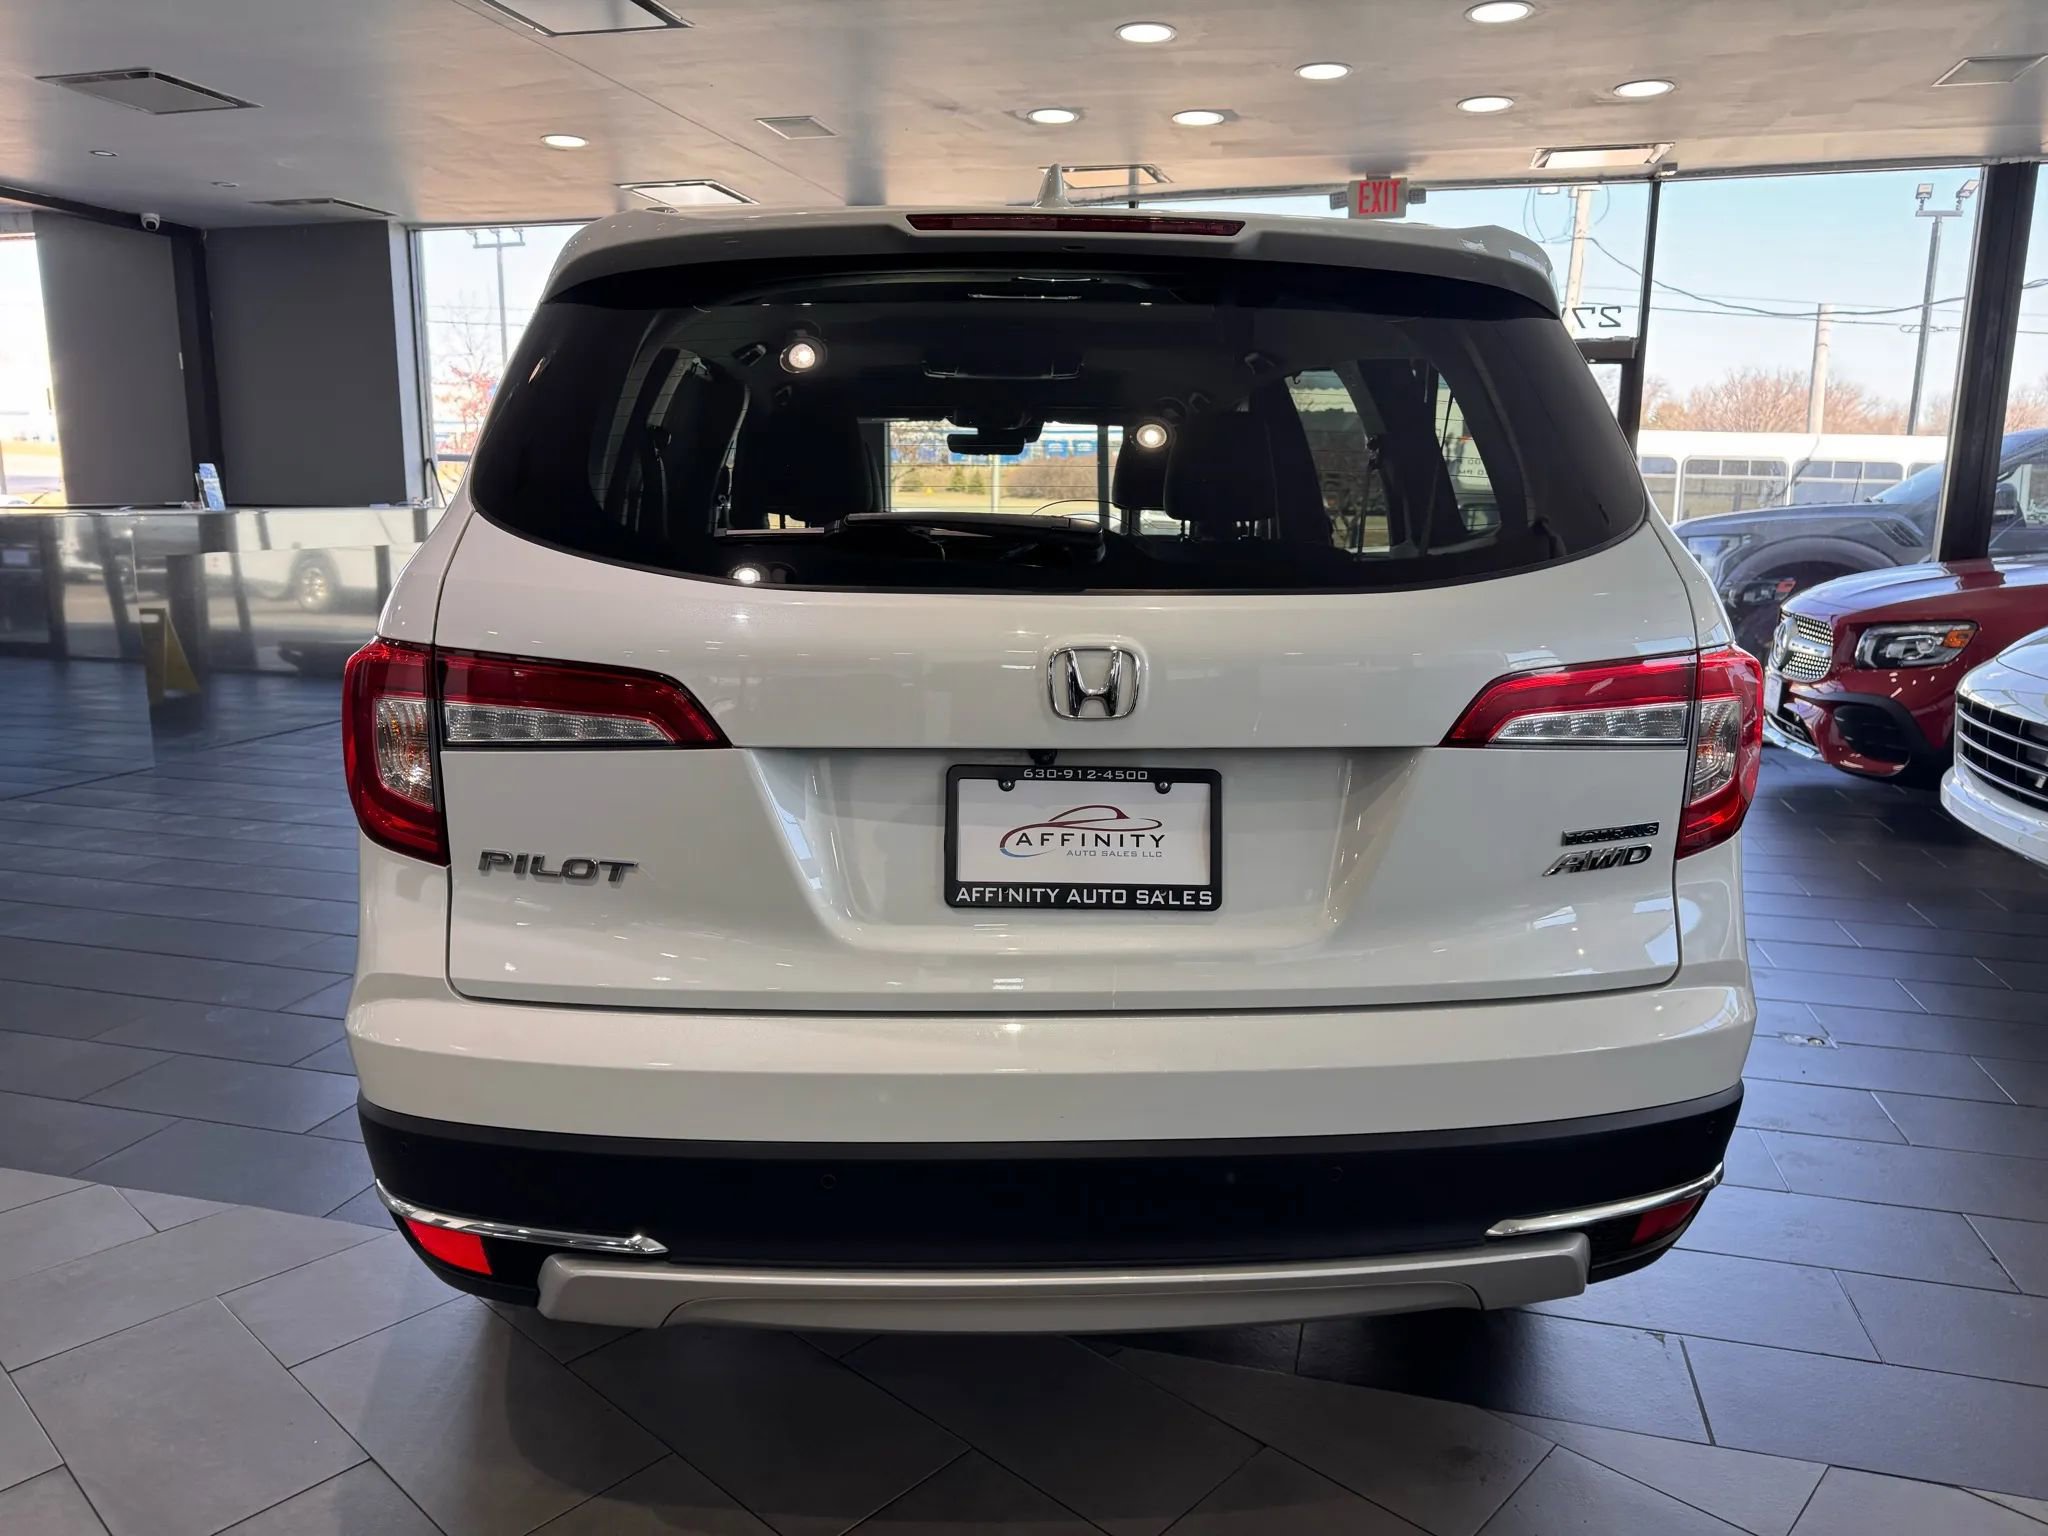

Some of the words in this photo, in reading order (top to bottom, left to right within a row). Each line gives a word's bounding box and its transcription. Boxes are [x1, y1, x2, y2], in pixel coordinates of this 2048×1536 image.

[1358, 179, 1401, 214] EXIT
[1023, 768, 1148, 780] 630-912-4500
[1015, 832, 1166, 848] AFFINITY
[1142, 850, 1163, 858] LLC
[1542, 843, 1653, 877] AWD
[478, 849, 639, 883] PILOT
[955, 887, 1060, 903] AFFINITY
[1066, 889, 1127, 904] AUTO
[1136, 890, 1212, 906] SALES
